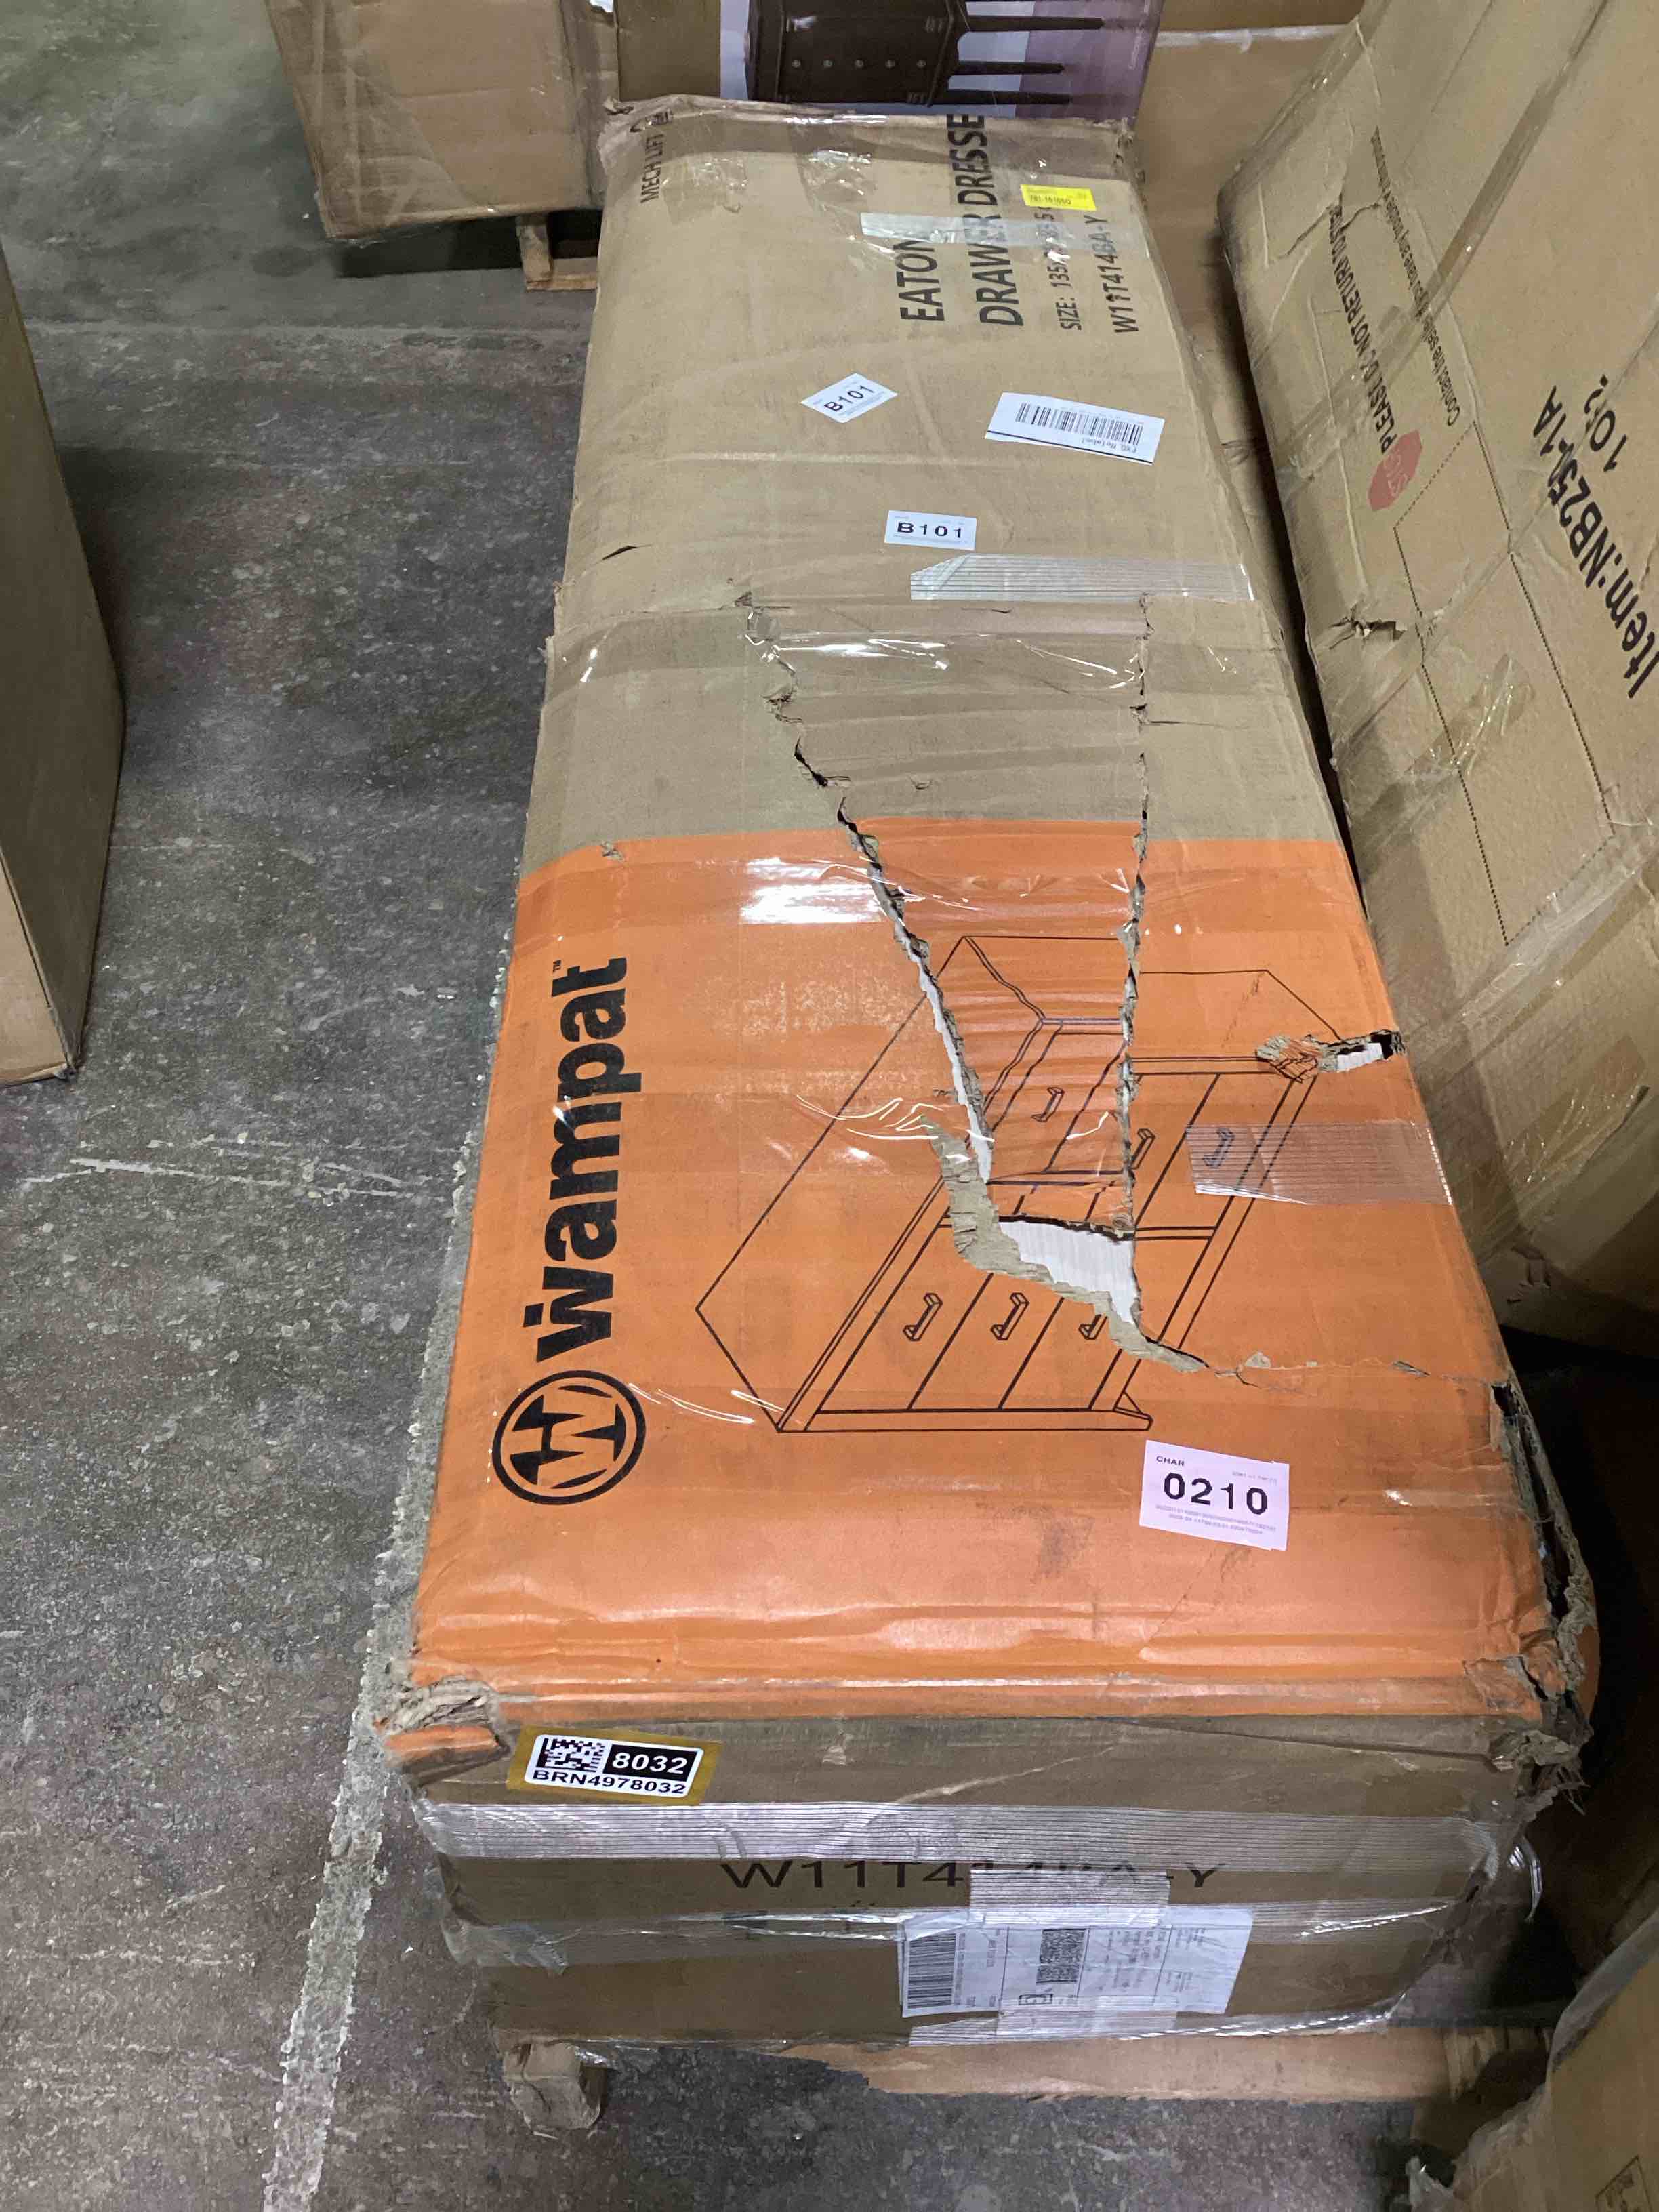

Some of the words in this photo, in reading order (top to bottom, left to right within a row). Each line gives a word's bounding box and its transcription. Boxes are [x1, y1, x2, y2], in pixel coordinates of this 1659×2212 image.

[893, 237, 945, 321] EATON
[962, 213, 1023, 326] DRAWER
[1056, 296, 1082, 331] SIZE:
[1351, 314, 1370, 358] NOT
[824, 385, 875, 412] B101
[1436, 366, 1460, 426] Contact
[1603, 433, 1627, 472] 1
[897, 521, 962, 539] B101
[1156, 1455, 1185, 1467] CHAR
[1164, 1472, 1268, 1515] 0210
[532, 1769, 687, 1795] BRN4978032
[611, 1752, 688, 1775] 8032
